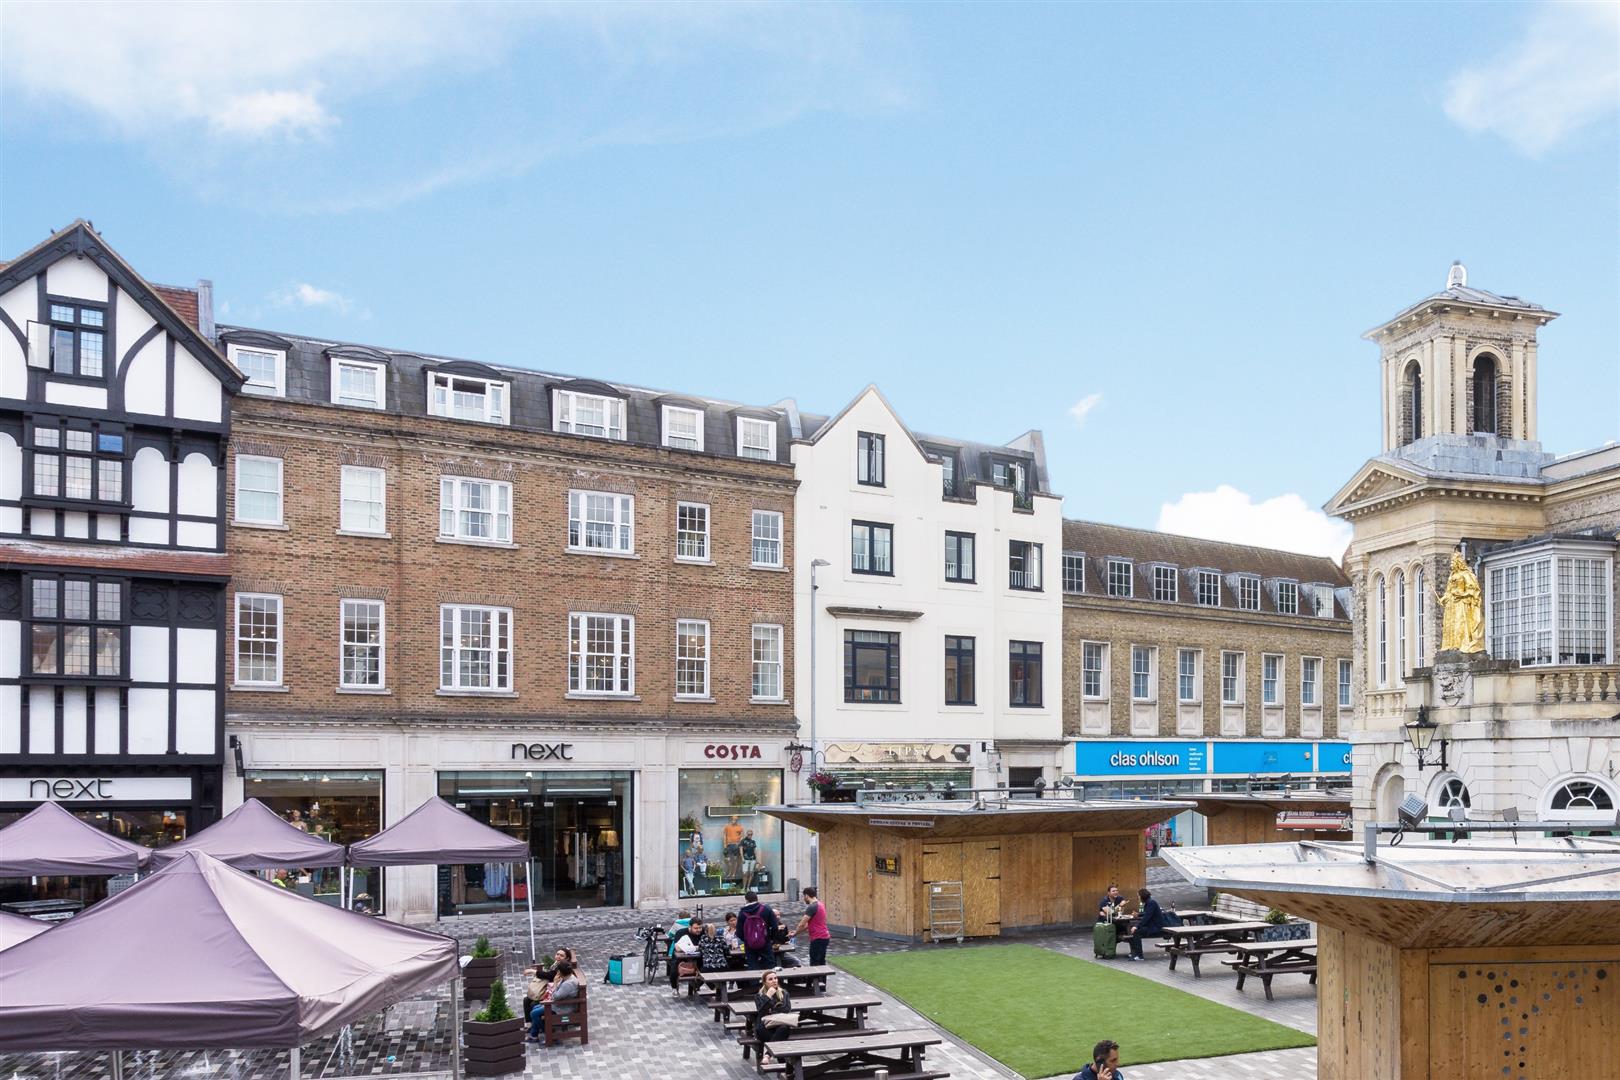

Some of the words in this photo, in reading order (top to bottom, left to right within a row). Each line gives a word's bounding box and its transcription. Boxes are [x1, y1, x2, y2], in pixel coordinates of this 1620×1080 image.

[511, 743, 573, 760] next
[704, 745, 761, 760] COSTA
[1110, 751, 1137, 766] clas
[1139, 751, 1179, 766] ohlson
[30, 779, 112, 798] next
